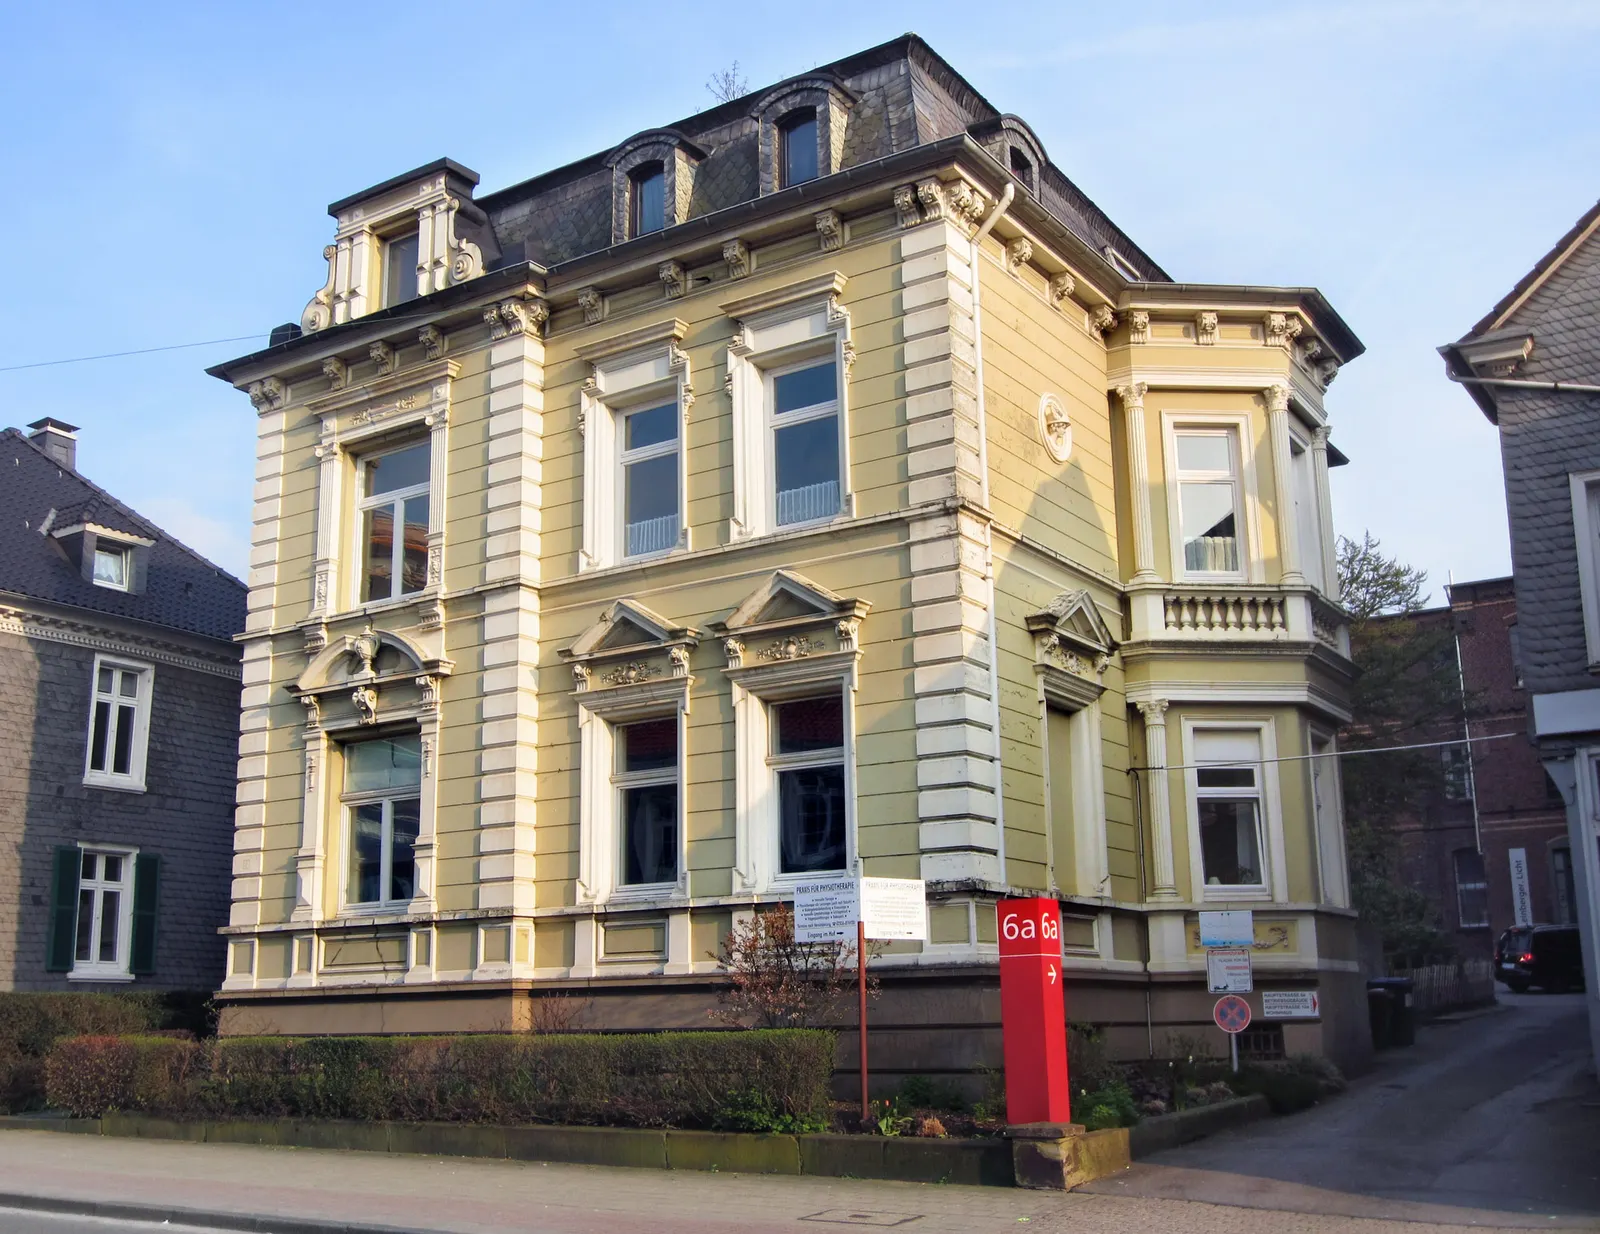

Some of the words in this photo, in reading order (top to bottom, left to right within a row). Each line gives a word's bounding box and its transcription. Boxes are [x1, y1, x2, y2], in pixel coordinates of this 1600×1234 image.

[1515, 860, 1523, 879] Licht
[796, 885, 811, 894] PRAXIS
[810, 883, 820, 893] FÜR
[820, 881, 855, 892] PHYSIOTHERAPIE
[1002, 913, 1036, 940] 6a
[1041, 912, 1058, 940] 6a
